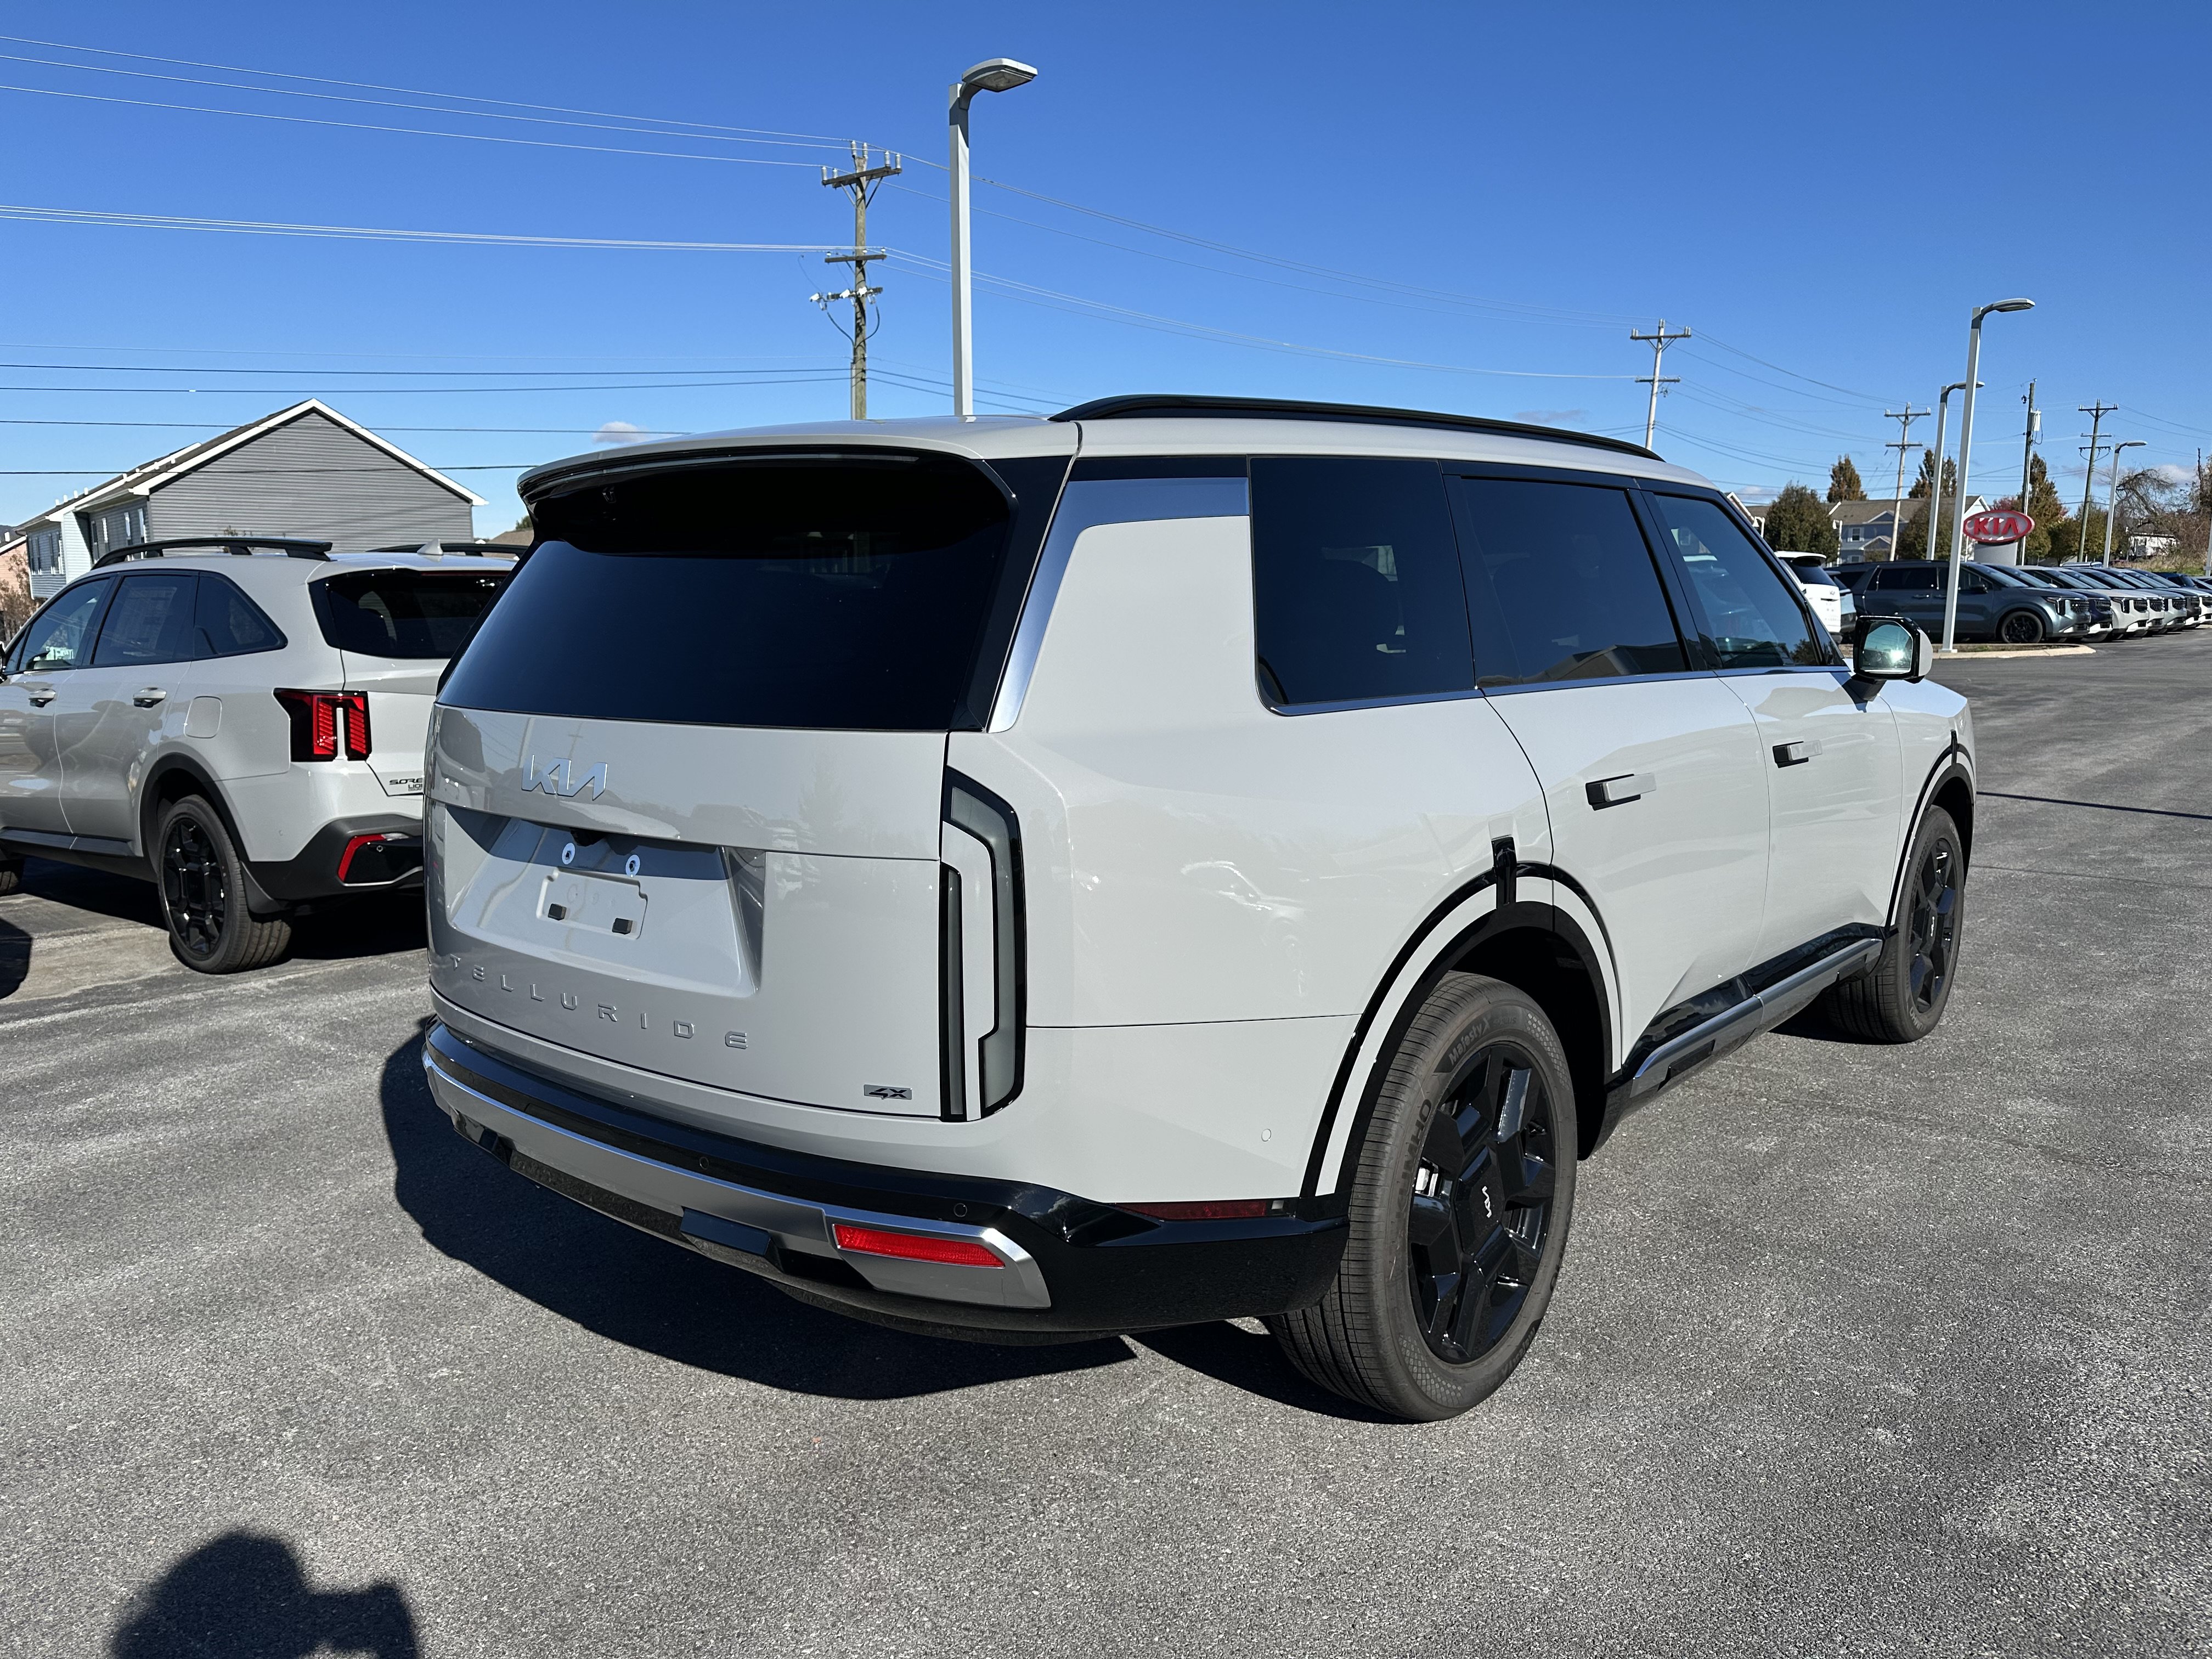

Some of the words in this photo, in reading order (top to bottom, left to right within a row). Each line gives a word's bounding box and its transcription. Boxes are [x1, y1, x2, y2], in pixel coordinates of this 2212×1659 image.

[1973, 517, 2019, 535] KIA
[522, 754, 608, 801] KIA
[450, 954, 748, 1049] TELLURIDE
